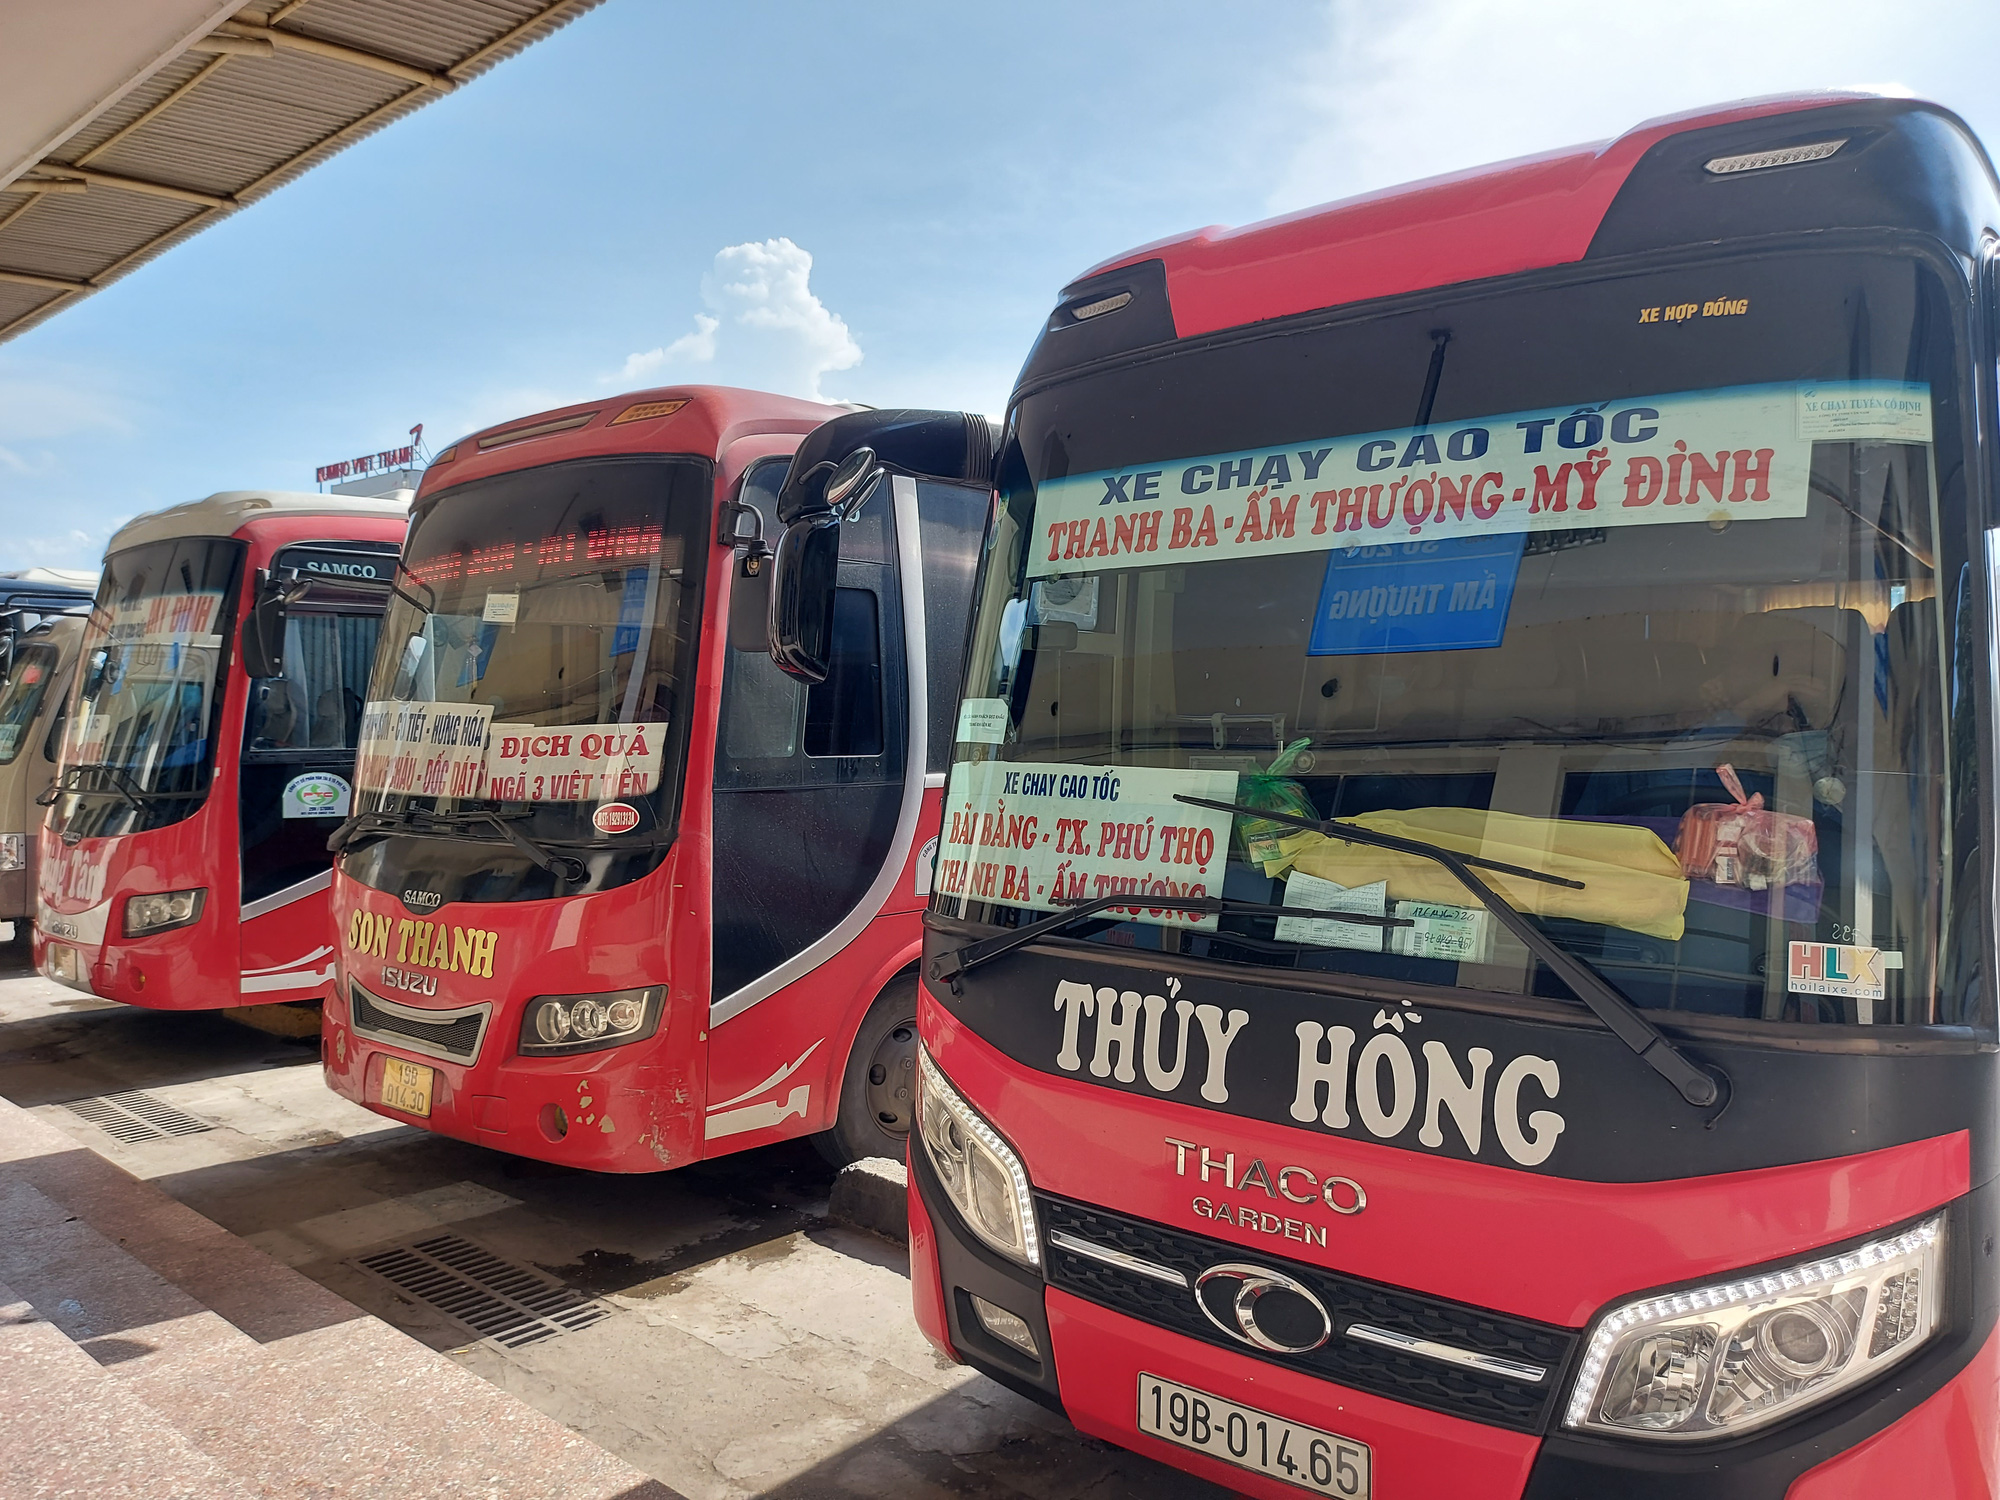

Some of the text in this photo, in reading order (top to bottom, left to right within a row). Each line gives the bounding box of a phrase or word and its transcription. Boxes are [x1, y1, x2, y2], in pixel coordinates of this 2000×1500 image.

[1639, 296, 1748, 325] XE HỢP ĐỒNG
[1805, 402, 1818, 412] XE
[1098, 400, 1660, 506] XE CHẠY CAO TỐC
[1047, 509, 1164, 562] THANH
[1621, 439, 1775, 508] ĐÌNH
[307, 561, 377, 579] SAMCO
[460, 709, 485, 747] HÓA
[500, 734, 573, 765] ĐỊCH
[580, 725, 650, 761] QUẢ
[490, 771, 527, 801] NGÃ
[532, 775, 545, 800] 3
[1003, 771, 1020, 794] XE
[1059, 774, 1088, 799] CAO
[1092, 769, 1121, 801] TỐC
[949, 802, 979, 845] BÃI
[979, 798, 1038, 850] BẰNG
[1097, 816, 1154, 861] PHÚ
[1160, 825, 1214, 874] THỌ
[403, 889, 441, 908] SAMCO
[940, 859, 1000, 898] THANH
[1000, 865, 1031, 902] BA
[348, 908, 499, 979] SON THANH
[381, 965, 438, 997] ISUZU
[1790, 944, 1881, 986] HLX
[1791, 981, 1882, 998] hoilaixe.com
[386, 1064, 426, 1113] 19B 014.30
[1054, 976, 1566, 1166] THỦY HỒNG
[1165, 1136, 1368, 1217] THACO
[1192, 1196, 1328, 1248] GARDEN
[1151, 1385, 1360, 1495] 19B-014.65
